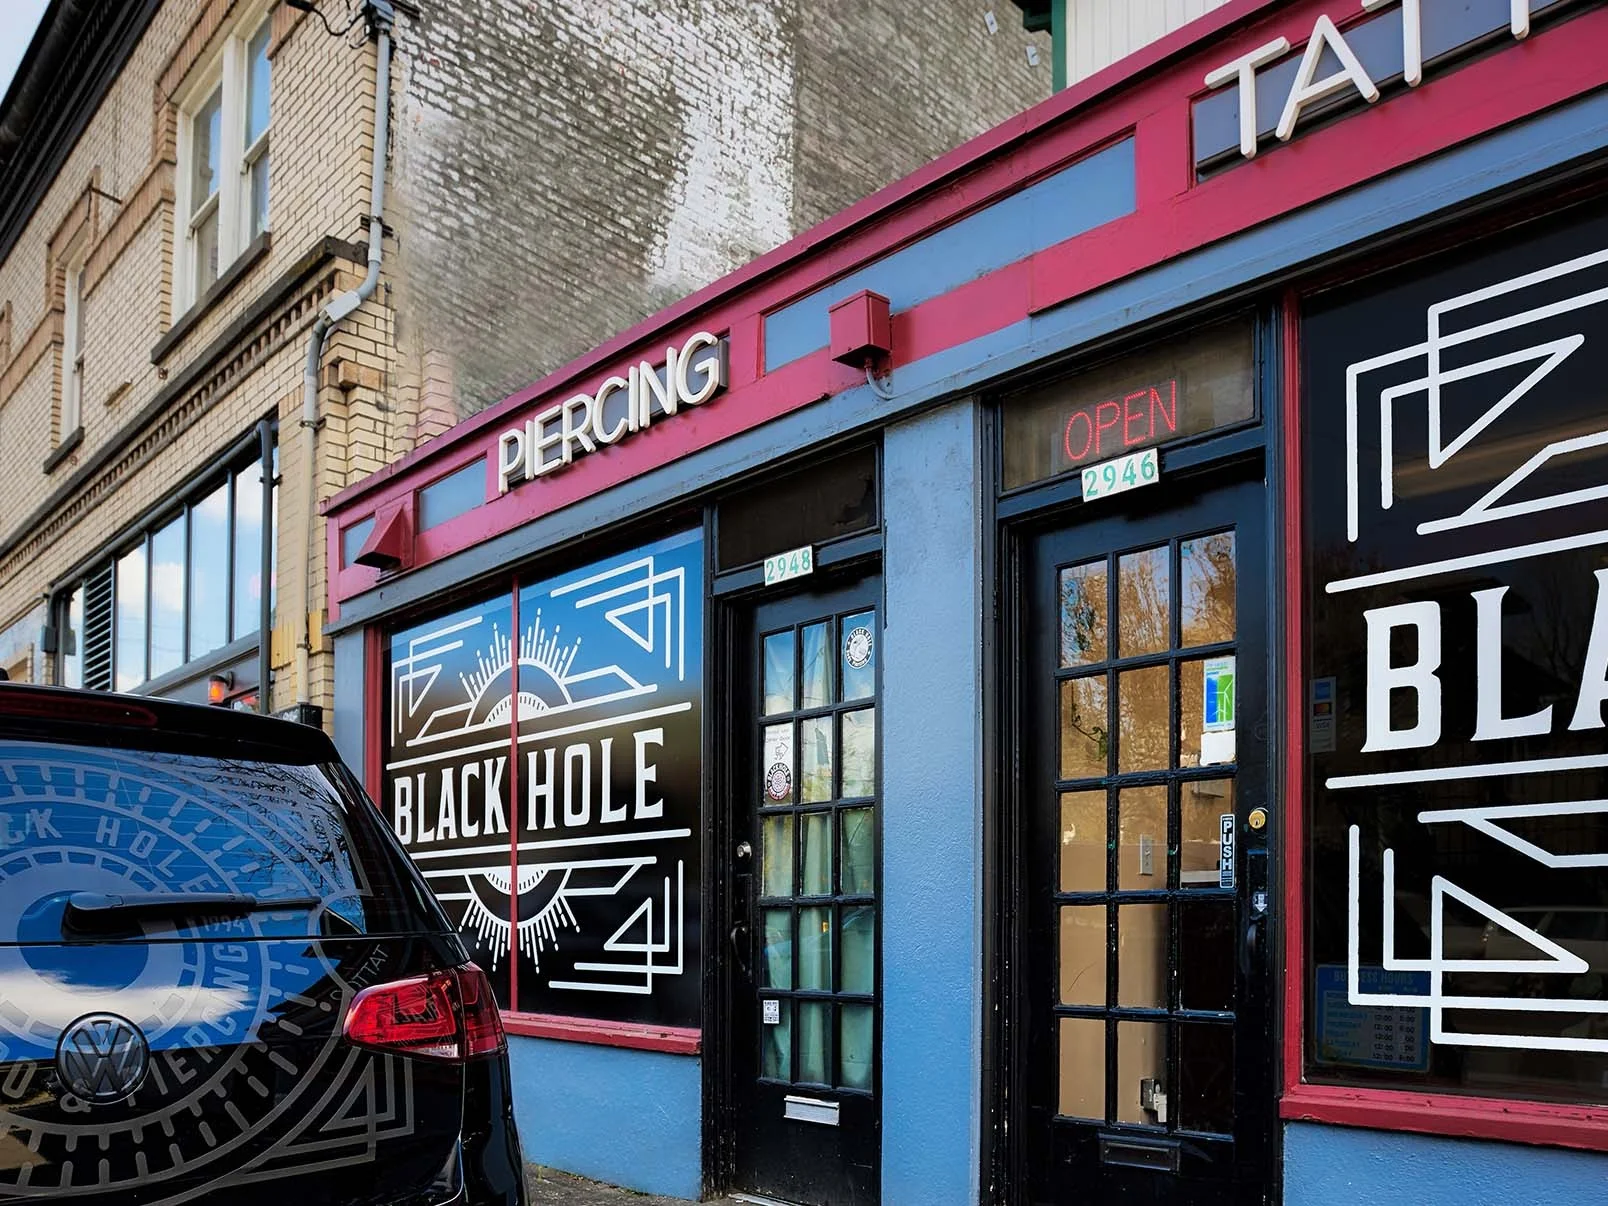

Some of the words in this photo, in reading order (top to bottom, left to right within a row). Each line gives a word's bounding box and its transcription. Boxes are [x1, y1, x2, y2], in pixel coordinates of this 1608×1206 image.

[498, 331, 720, 495] PIERCING
[1065, 379, 1176, 461] OPEN
[1085, 452, 1155, 498] 2946
[766, 549, 811, 582] 2948
[394, 756, 509, 846] BLACK
[526, 727, 664, 831] HOLE
[95, 815, 220, 894] HOLE
[1222, 820, 1233, 870] PUSH
[127, 943, 250, 1106] IERCING
